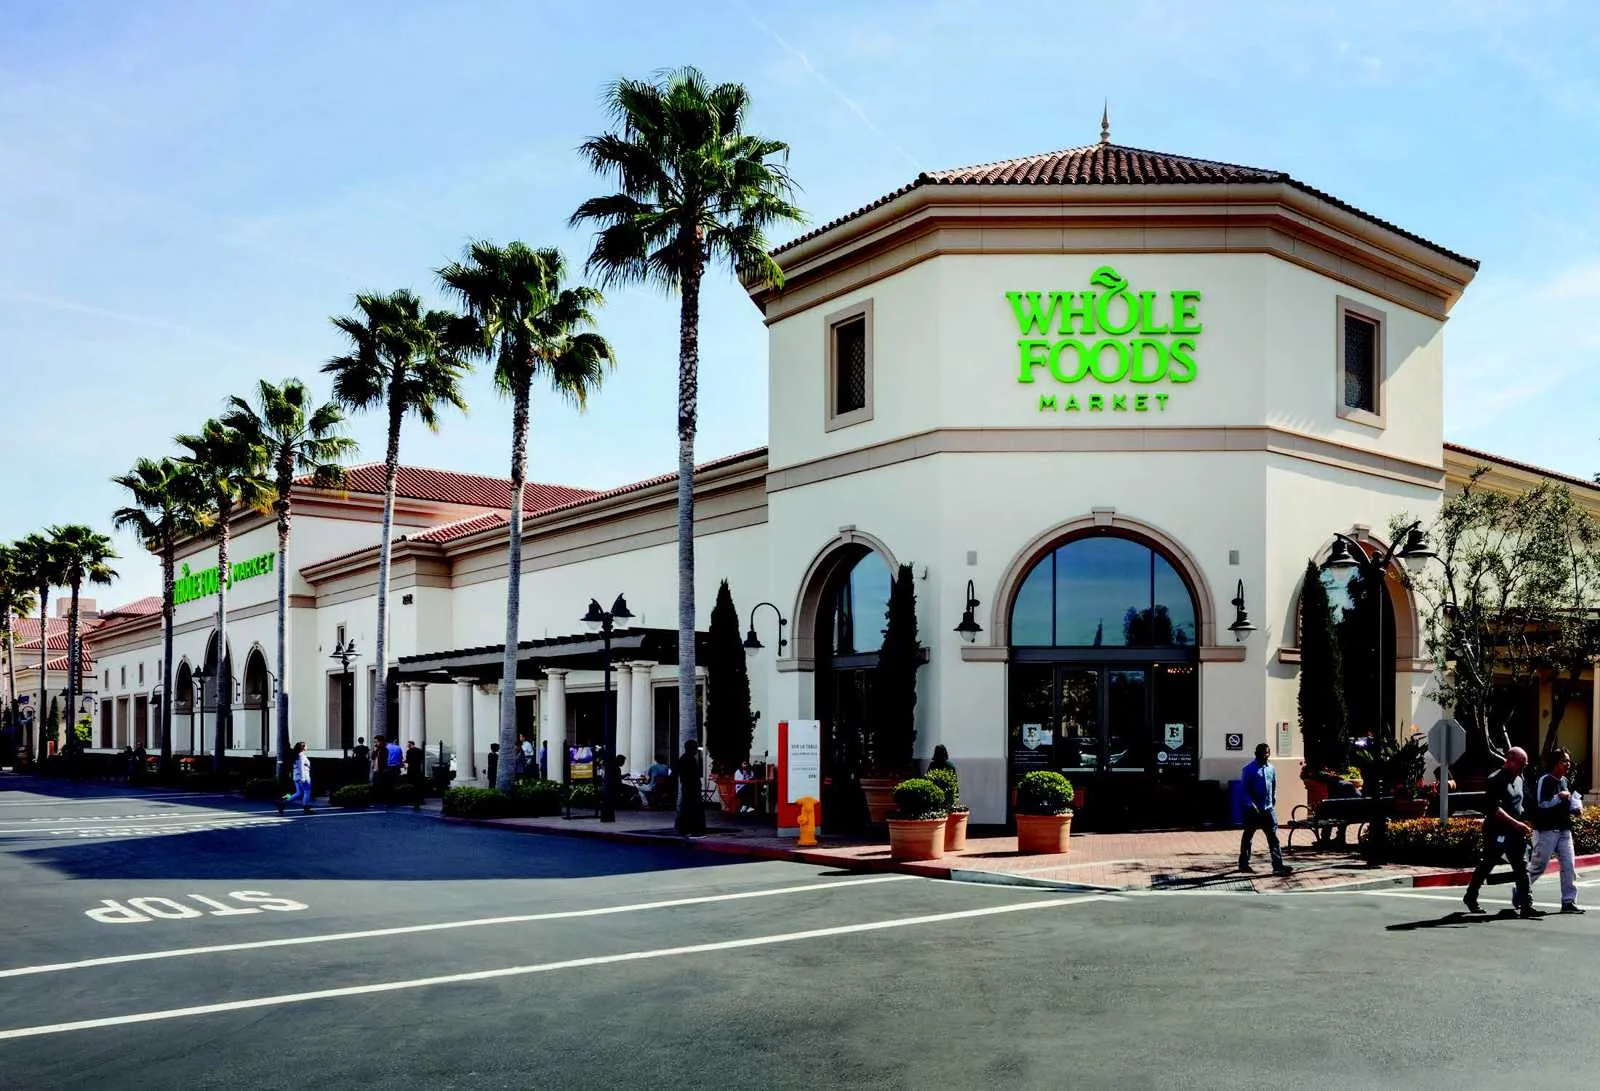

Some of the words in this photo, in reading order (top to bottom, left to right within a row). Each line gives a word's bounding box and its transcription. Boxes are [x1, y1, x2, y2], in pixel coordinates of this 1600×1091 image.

[1005, 290, 1203, 336] WHOLE
[1017, 338, 1198, 384] FOODS
[1038, 393, 1170, 412] MARKET
[201, 560, 232, 597] FOOS
[233, 552, 276, 583] MARKET
[84, 890, 310, 923] STOP
